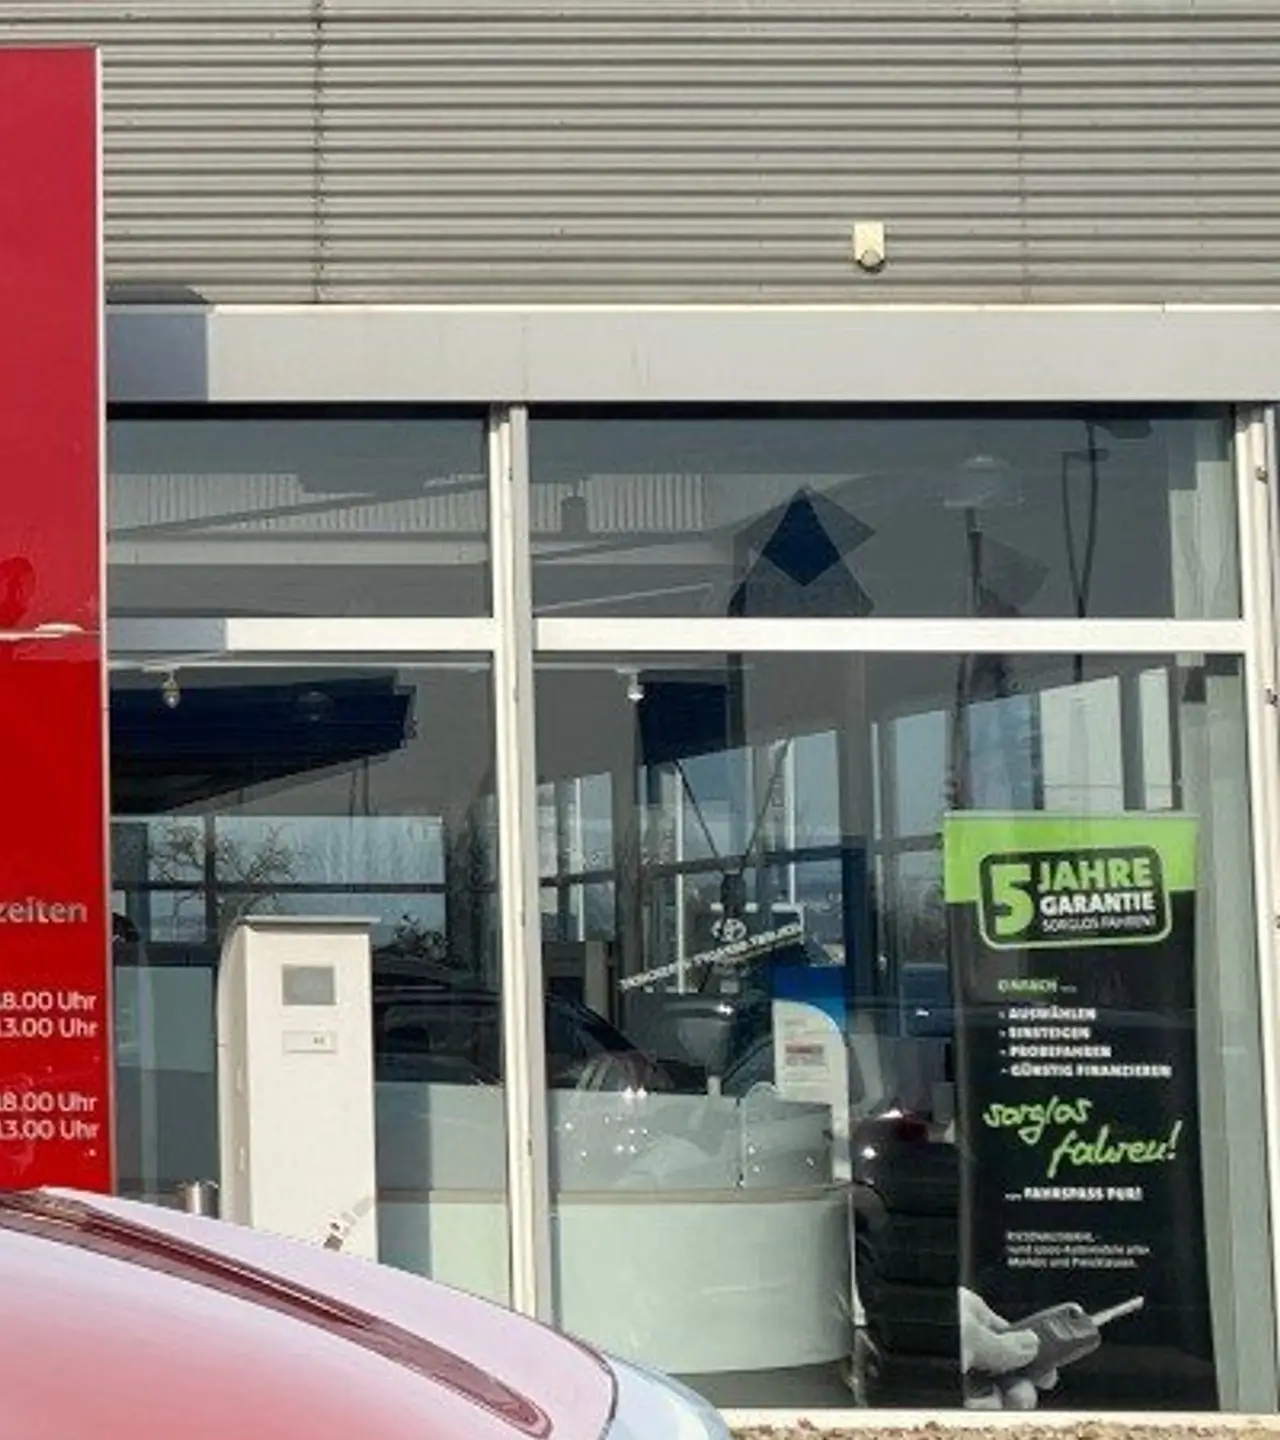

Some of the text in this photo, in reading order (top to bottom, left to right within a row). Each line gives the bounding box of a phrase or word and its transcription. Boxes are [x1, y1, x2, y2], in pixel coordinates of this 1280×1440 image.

[991, 857, 1154, 936] 5 JAHRE
[1040, 891, 1156, 916] GARANTIE
[57, 990, 98, 1011] Uhr
[59, 1017, 99, 1037] Uhr
[58, 1092, 99, 1112] Uhr
[60, 1119, 101, 1140] Uhr
[983, 1095, 1093, 1145] sorglos
